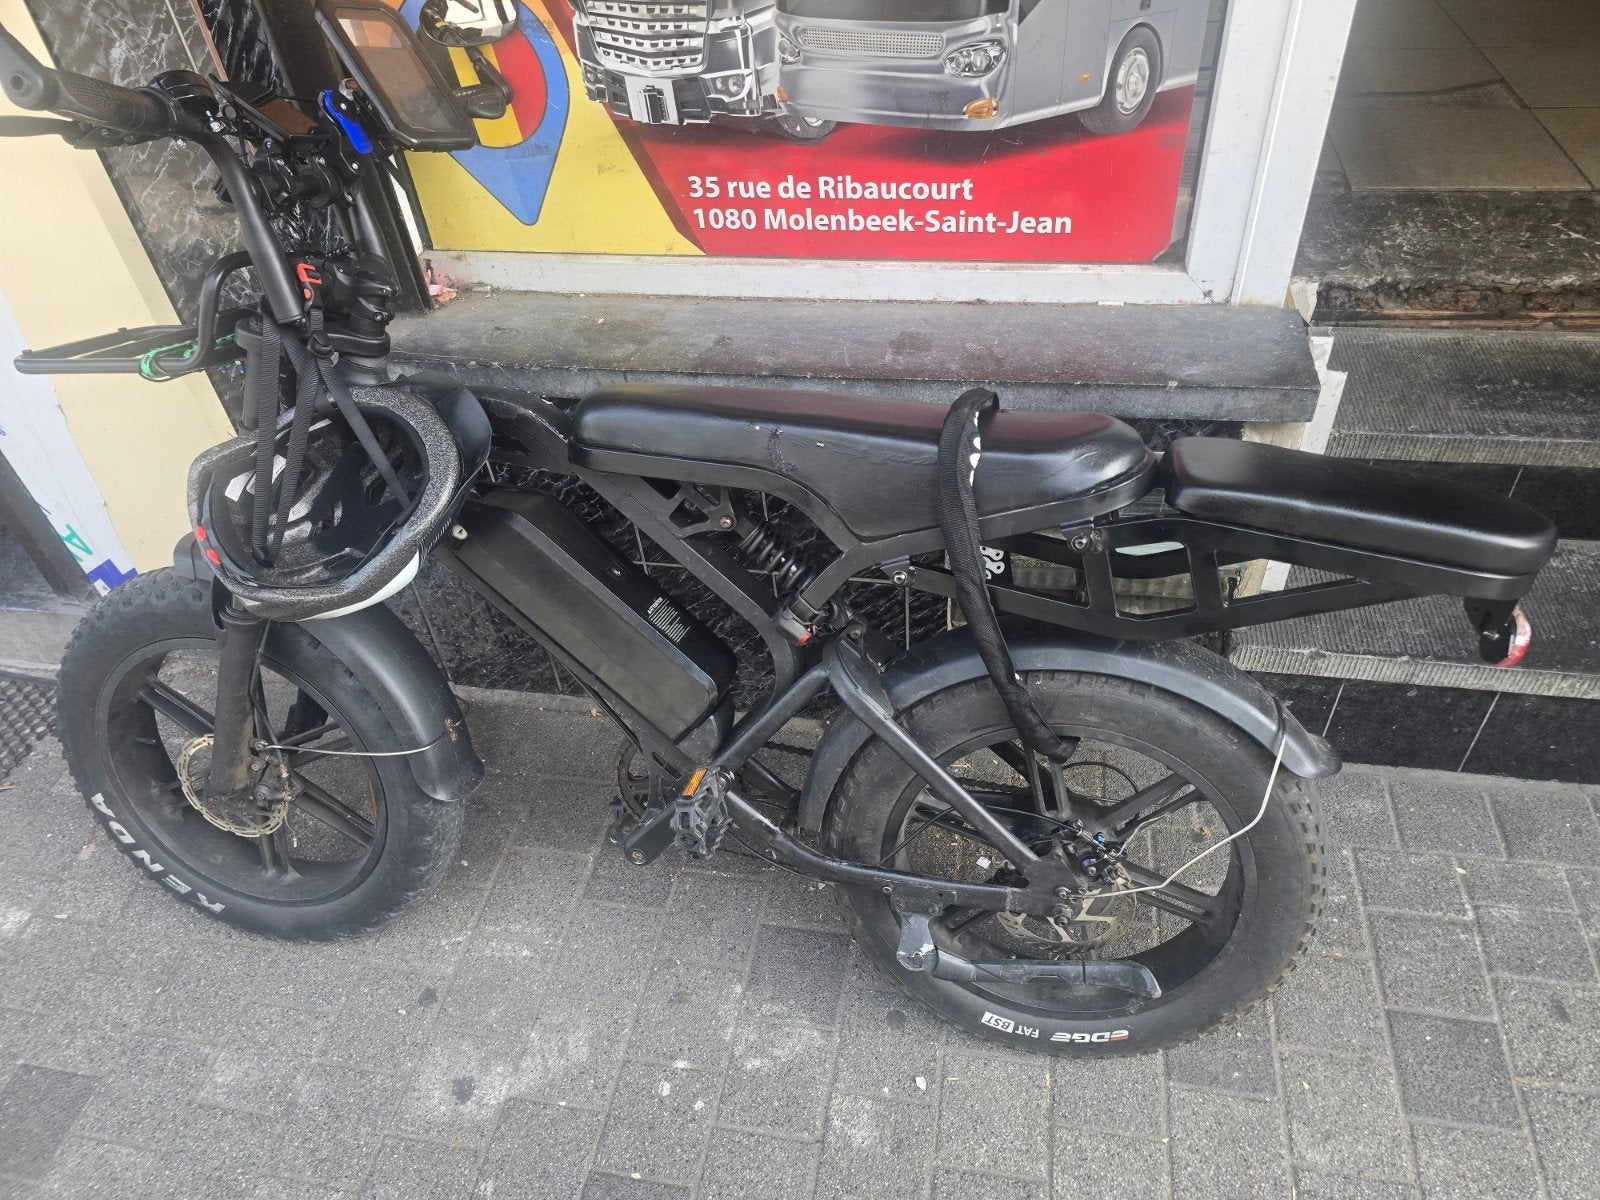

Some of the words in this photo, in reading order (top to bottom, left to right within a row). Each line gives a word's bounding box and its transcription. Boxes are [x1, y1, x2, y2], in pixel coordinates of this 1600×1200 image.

[688, 175, 720, 199] 35
[727, 180, 771, 199] rue
[778, 174, 812, 199] de
[818, 175, 974, 201] Ribaucourt
[693, 207, 757, 231] 1080
[764, 208, 1072, 234] Molenbeek-Saint-Jean
[91, 792, 226, 914] KENDA
[983, 1013, 1013, 1031] BST
[1014, 1024, 1040, 1039] FAT
